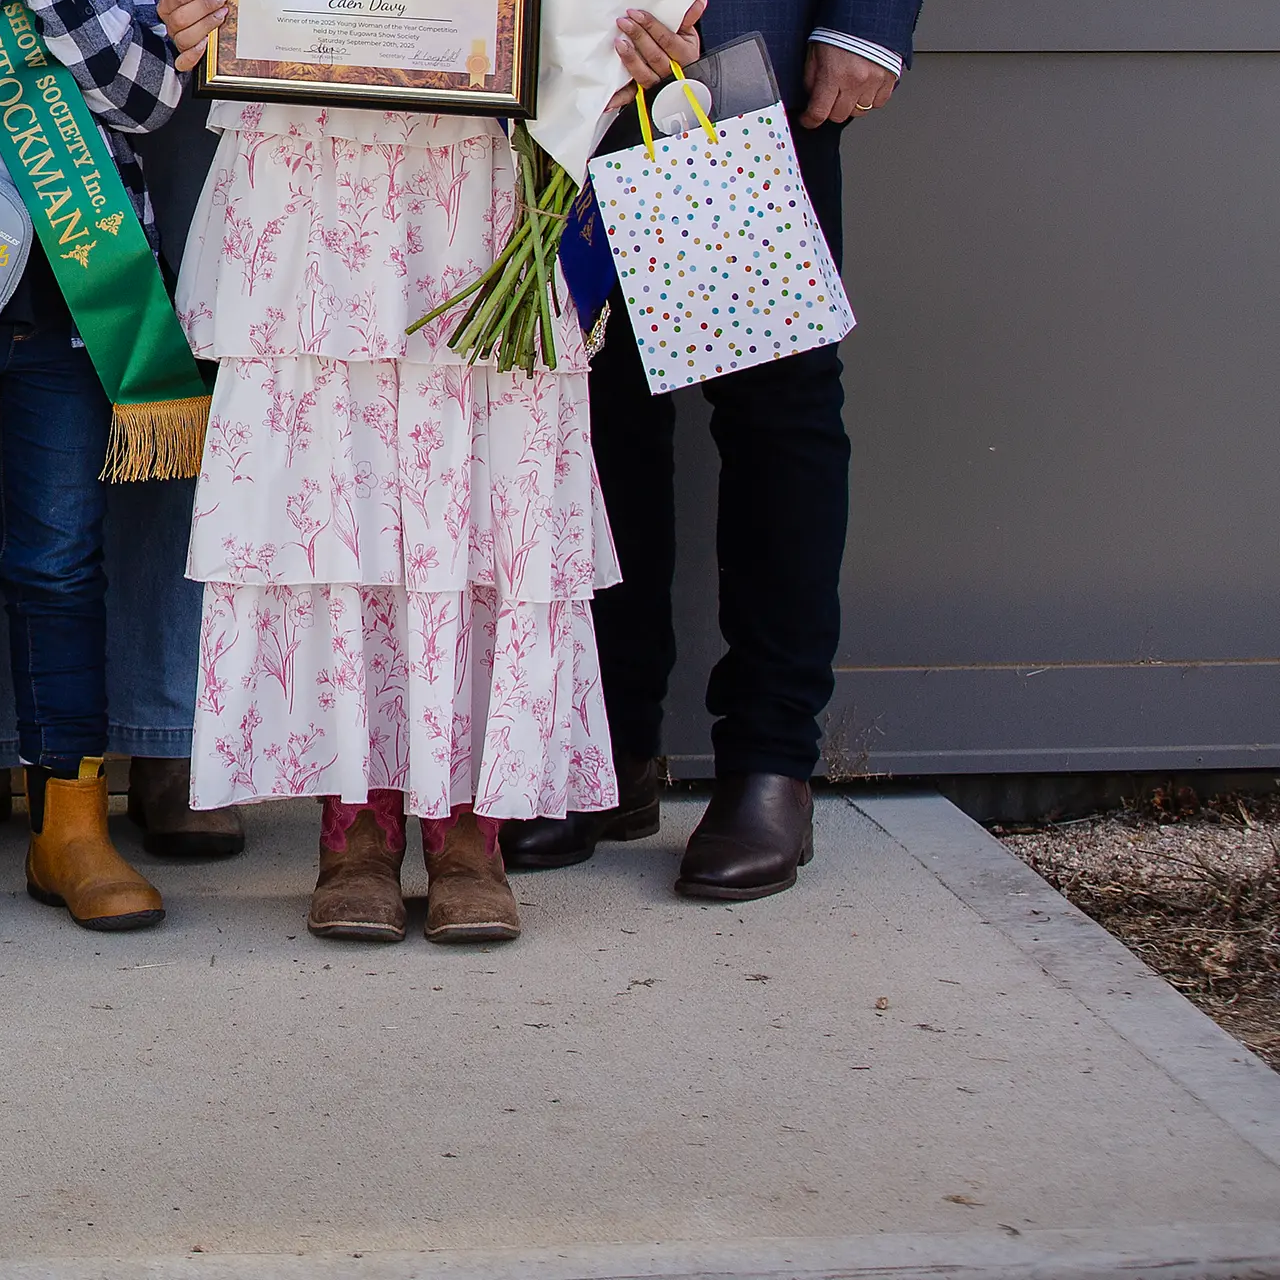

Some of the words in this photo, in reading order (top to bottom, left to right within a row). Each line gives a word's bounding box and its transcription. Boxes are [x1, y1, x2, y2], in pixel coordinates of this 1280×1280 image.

[336, 20, 357, 28] Young
[418, 26, 458, 34] Competition
[317, 37, 345, 45] Saturday
[346, 39, 381, 47] September
[397, 33, 420, 41] Society
[379, 52, 405, 60] Secretary
[4, 2, 49, 68] SHOW
[36, 75, 94, 169] SOCIETY
[81, 169, 107, 214] Inc.
